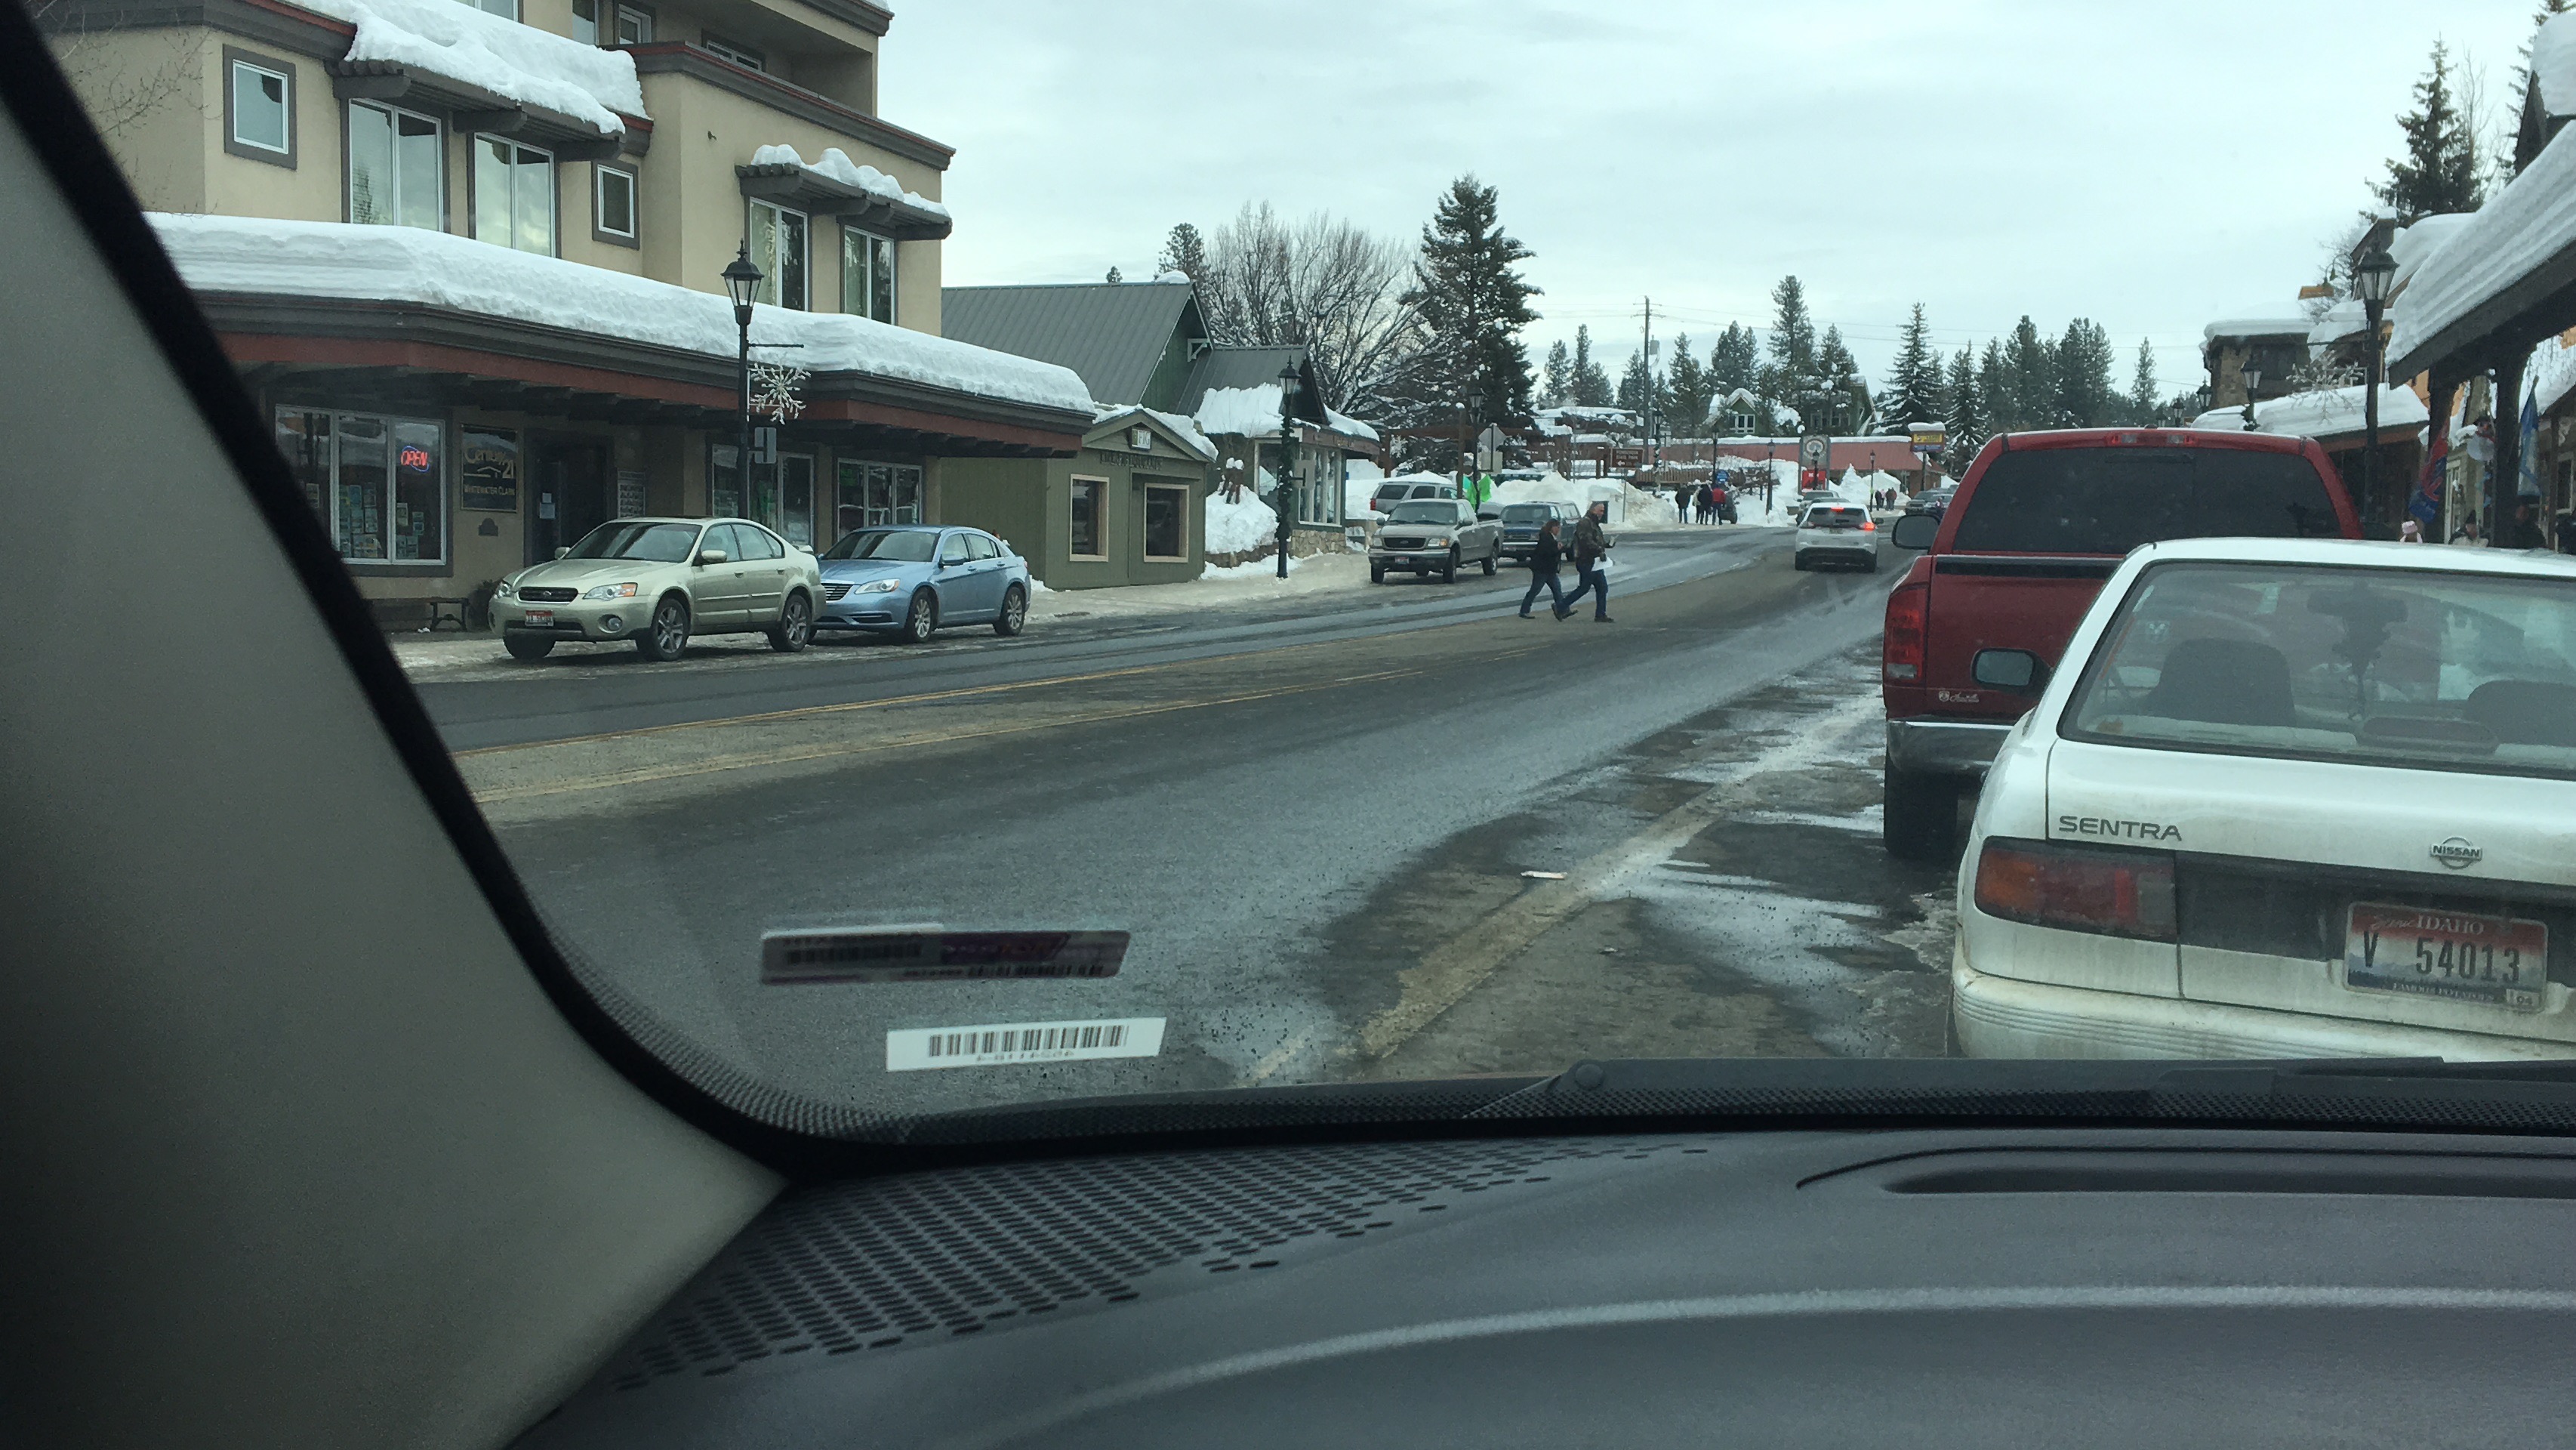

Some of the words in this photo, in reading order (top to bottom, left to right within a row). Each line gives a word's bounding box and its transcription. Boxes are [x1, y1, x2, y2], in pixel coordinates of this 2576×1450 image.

[1139, 430, 1150, 446] FIG
[401, 451, 428, 467] OPEN
[501, 459, 514, 479] 21
[2059, 815, 2182, 841] SENTRA
[2433, 845, 2480, 858] NISSAN
[2417, 914, 2485, 935] IDAHO
[2363, 930, 2379, 968] V
[2415, 936, 2520, 983] 54013
